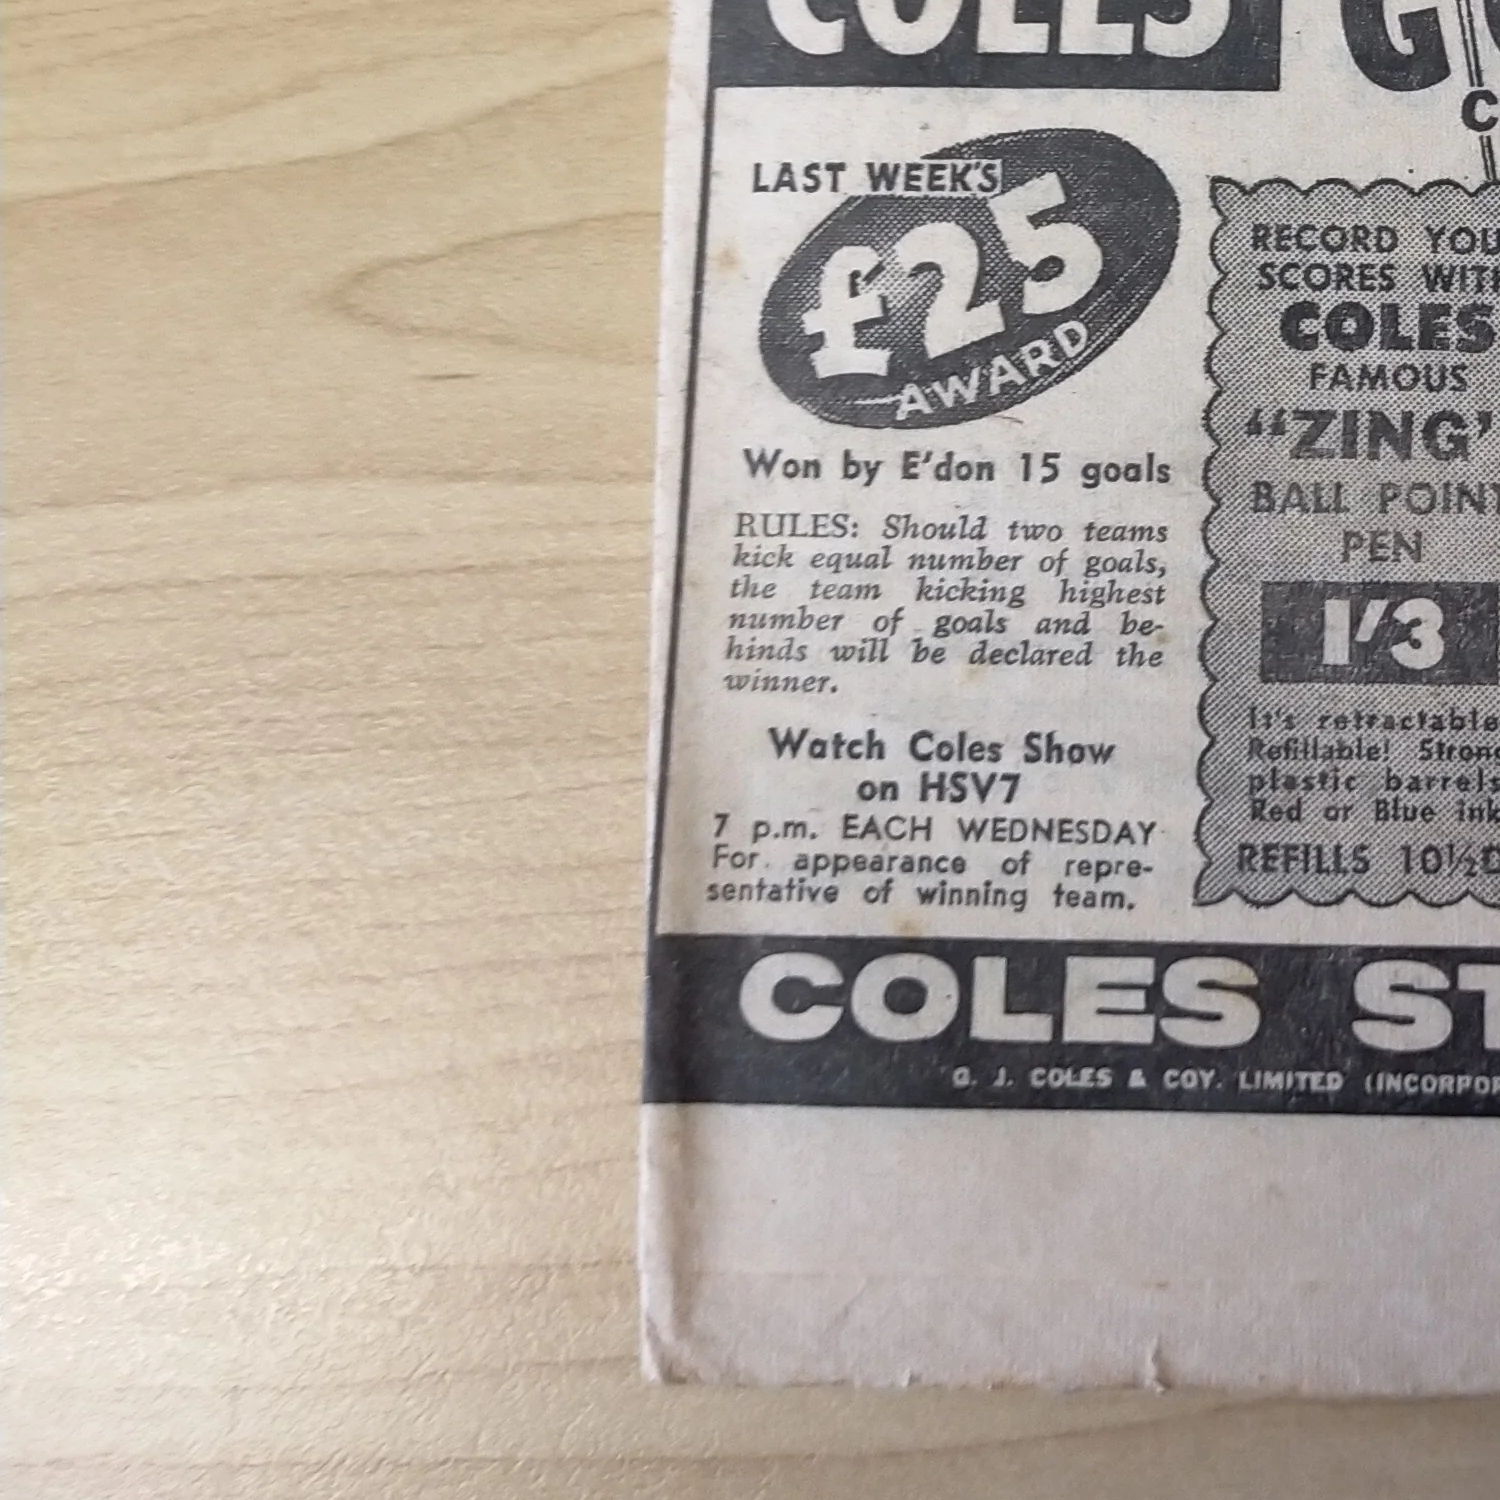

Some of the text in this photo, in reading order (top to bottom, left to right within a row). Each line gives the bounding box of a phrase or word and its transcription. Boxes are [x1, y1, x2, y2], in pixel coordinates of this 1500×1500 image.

[752, 160, 1000, 194] LAST WEEK'S
[1252, 224, 1399, 252] RECORD
[801, 170, 1104, 379] £25
[1257, 263, 1397, 292] SCORES
[1279, 301, 1498, 353] COLES
[895, 318, 1091, 419] AWARD
[1309, 364, 1468, 392] FAMOUS
[742, 447, 1171, 490] Won by E'don 15 goals
[1250, 481, 1350, 513] BALL
[734, 512, 1169, 544] RULES: Should two teams
[732, 542, 1167, 579] kick equal number of goals,
[1341, 530, 1423, 563] PEN
[730, 573, 1167, 610] the team kicking highest
[728, 604, 1165, 640] number of goals and be-
[725, 634, 1164, 668] hinds will be declared the
[722, 674, 838, 694] winner.
[767, 727, 1117, 765] Watch Coles Show
[1247, 738, 1390, 762] Refillable!
[856, 770, 1022, 805] on HSV7
[1248, 768, 1357, 795] plastic
[1250, 800, 1302, 822] Red
[1323, 804, 1353, 822] or
[1375, 800, 1437, 823] Blue
[714, 812, 1157, 846] 7 p.m. EACH WEDNESDAY
[793, 853, 967, 878] appearance
[1000, 849, 1031, 876] of
[1064, 859, 1154, 884] repre-
[1238, 843, 1371, 875] REFILLS
[707, 876, 1135, 913] sentative of winning team.
[739, 952, 1261, 1049] COLES
[1030, 1066, 1113, 1089] COLES
[1128, 1068, 1146, 1089] &
[1164, 1068, 1223, 1091] COY.
[1237, 1070, 1344, 1093] LIMITED
